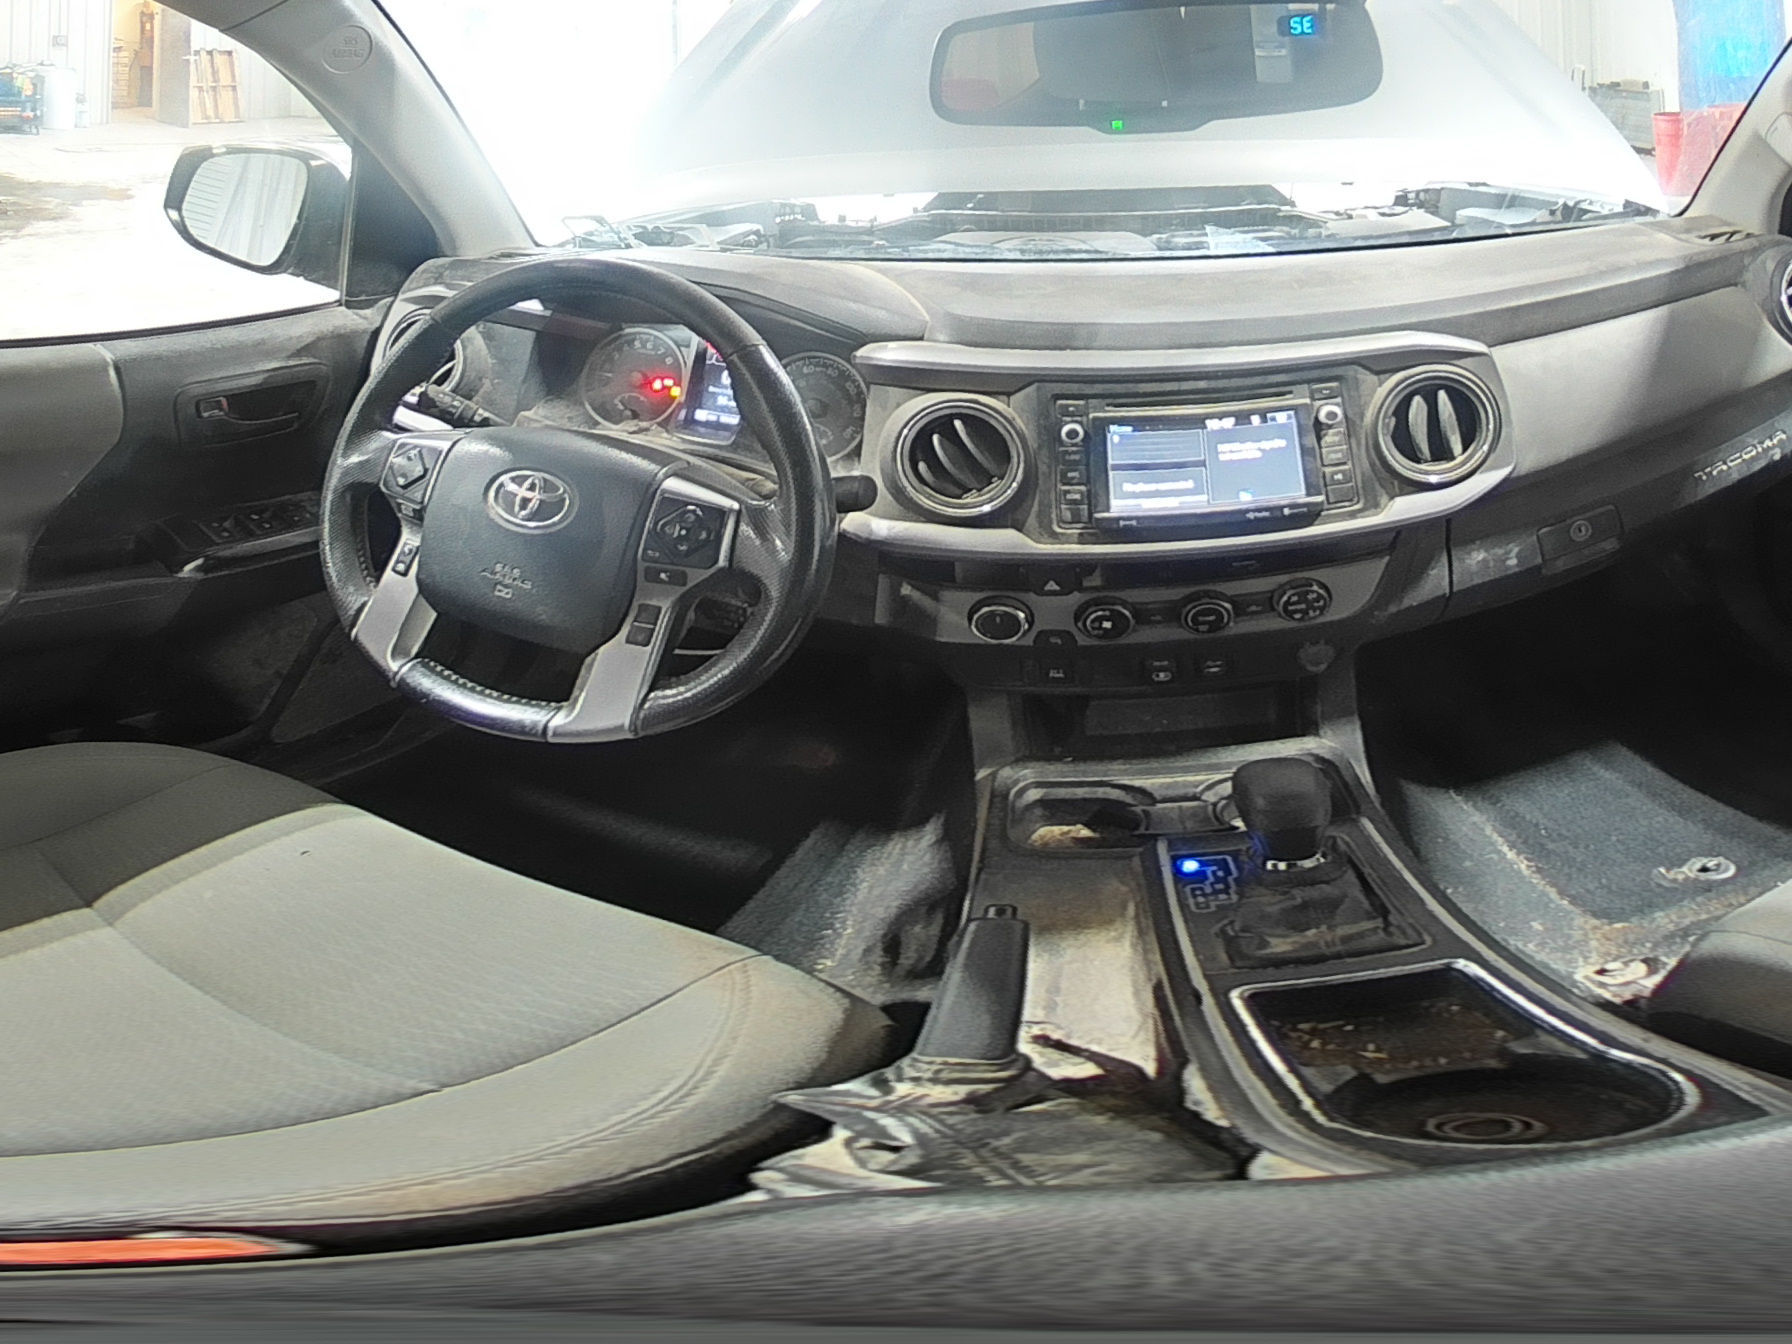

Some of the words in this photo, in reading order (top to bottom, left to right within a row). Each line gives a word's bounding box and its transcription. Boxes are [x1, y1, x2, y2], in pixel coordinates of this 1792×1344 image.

[1290, 15, 1313, 34] SE
[634, 340, 642, 348] 5
[646, 340, 654, 349] 6
[802, 365, 815, 374] 60
[1694, 430, 1787, 481] TACOMA
